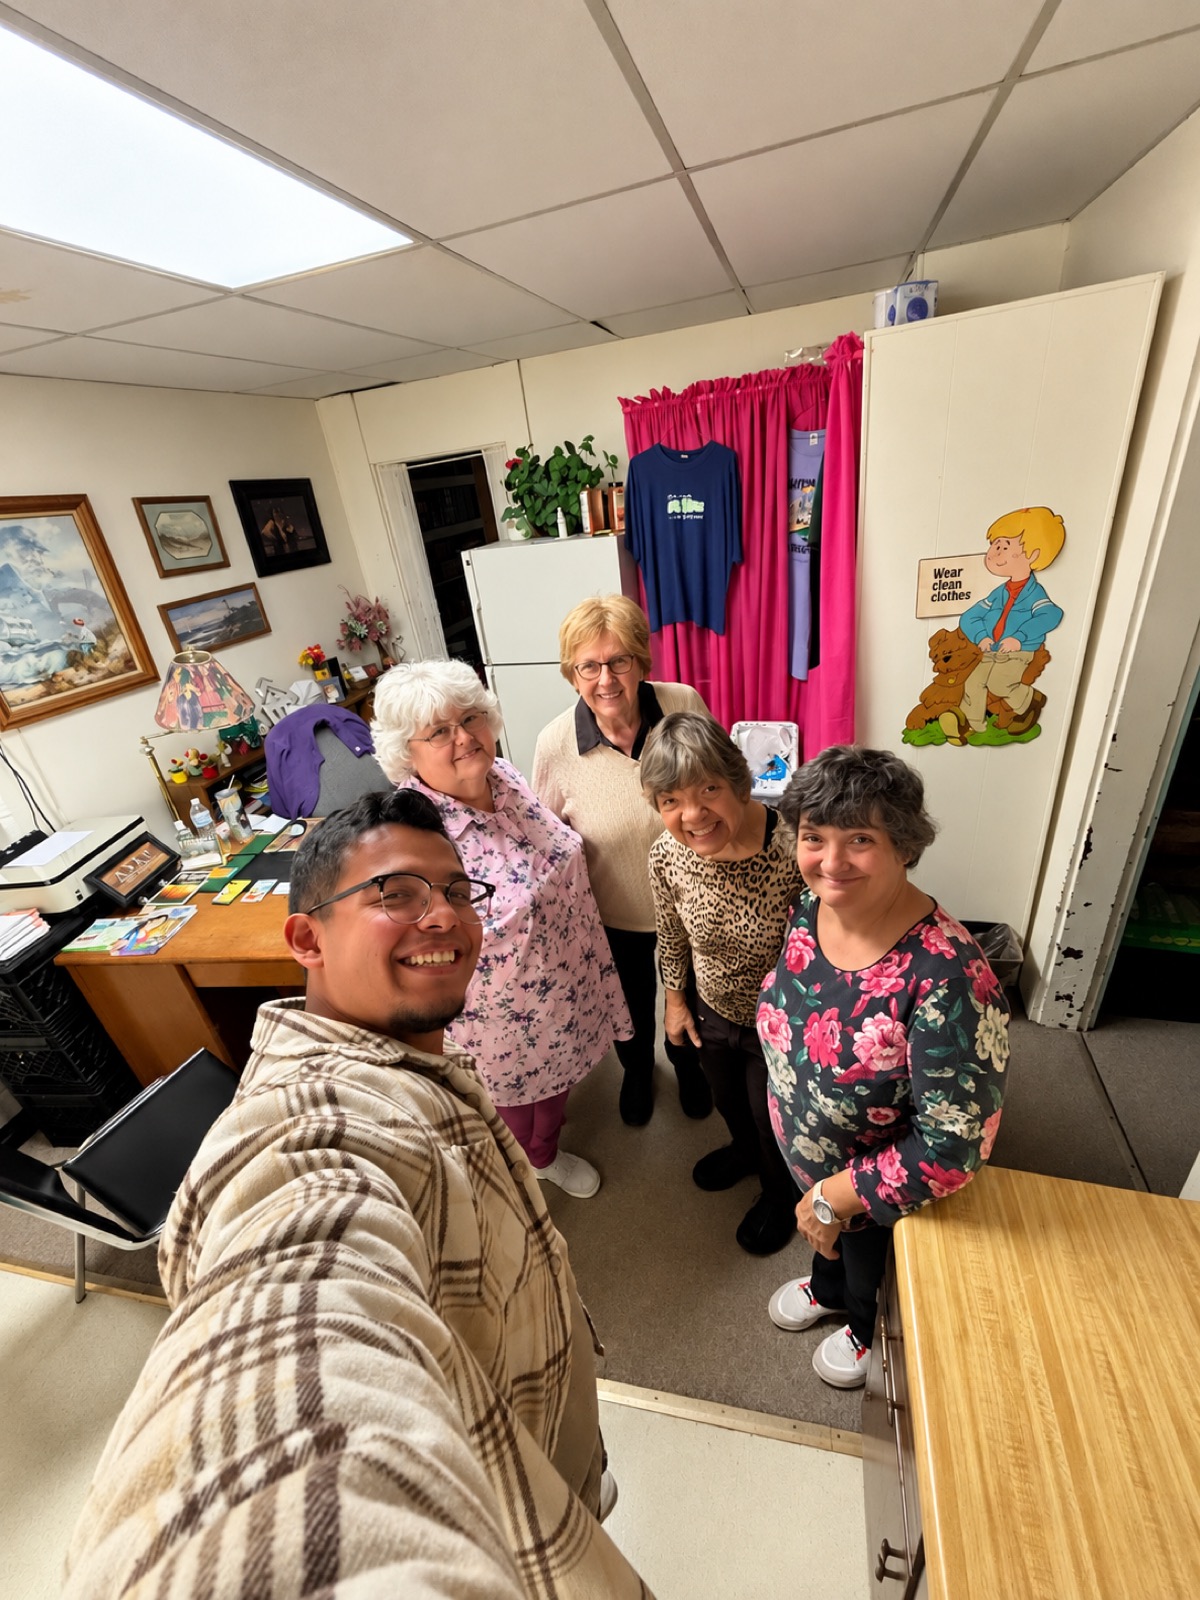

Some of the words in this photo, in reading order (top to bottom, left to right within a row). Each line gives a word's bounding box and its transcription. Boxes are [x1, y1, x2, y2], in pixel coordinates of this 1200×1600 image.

[933, 567, 964, 579] Wear
[932, 580, 962, 591] clean
[931, 591, 971, 602] clothes
